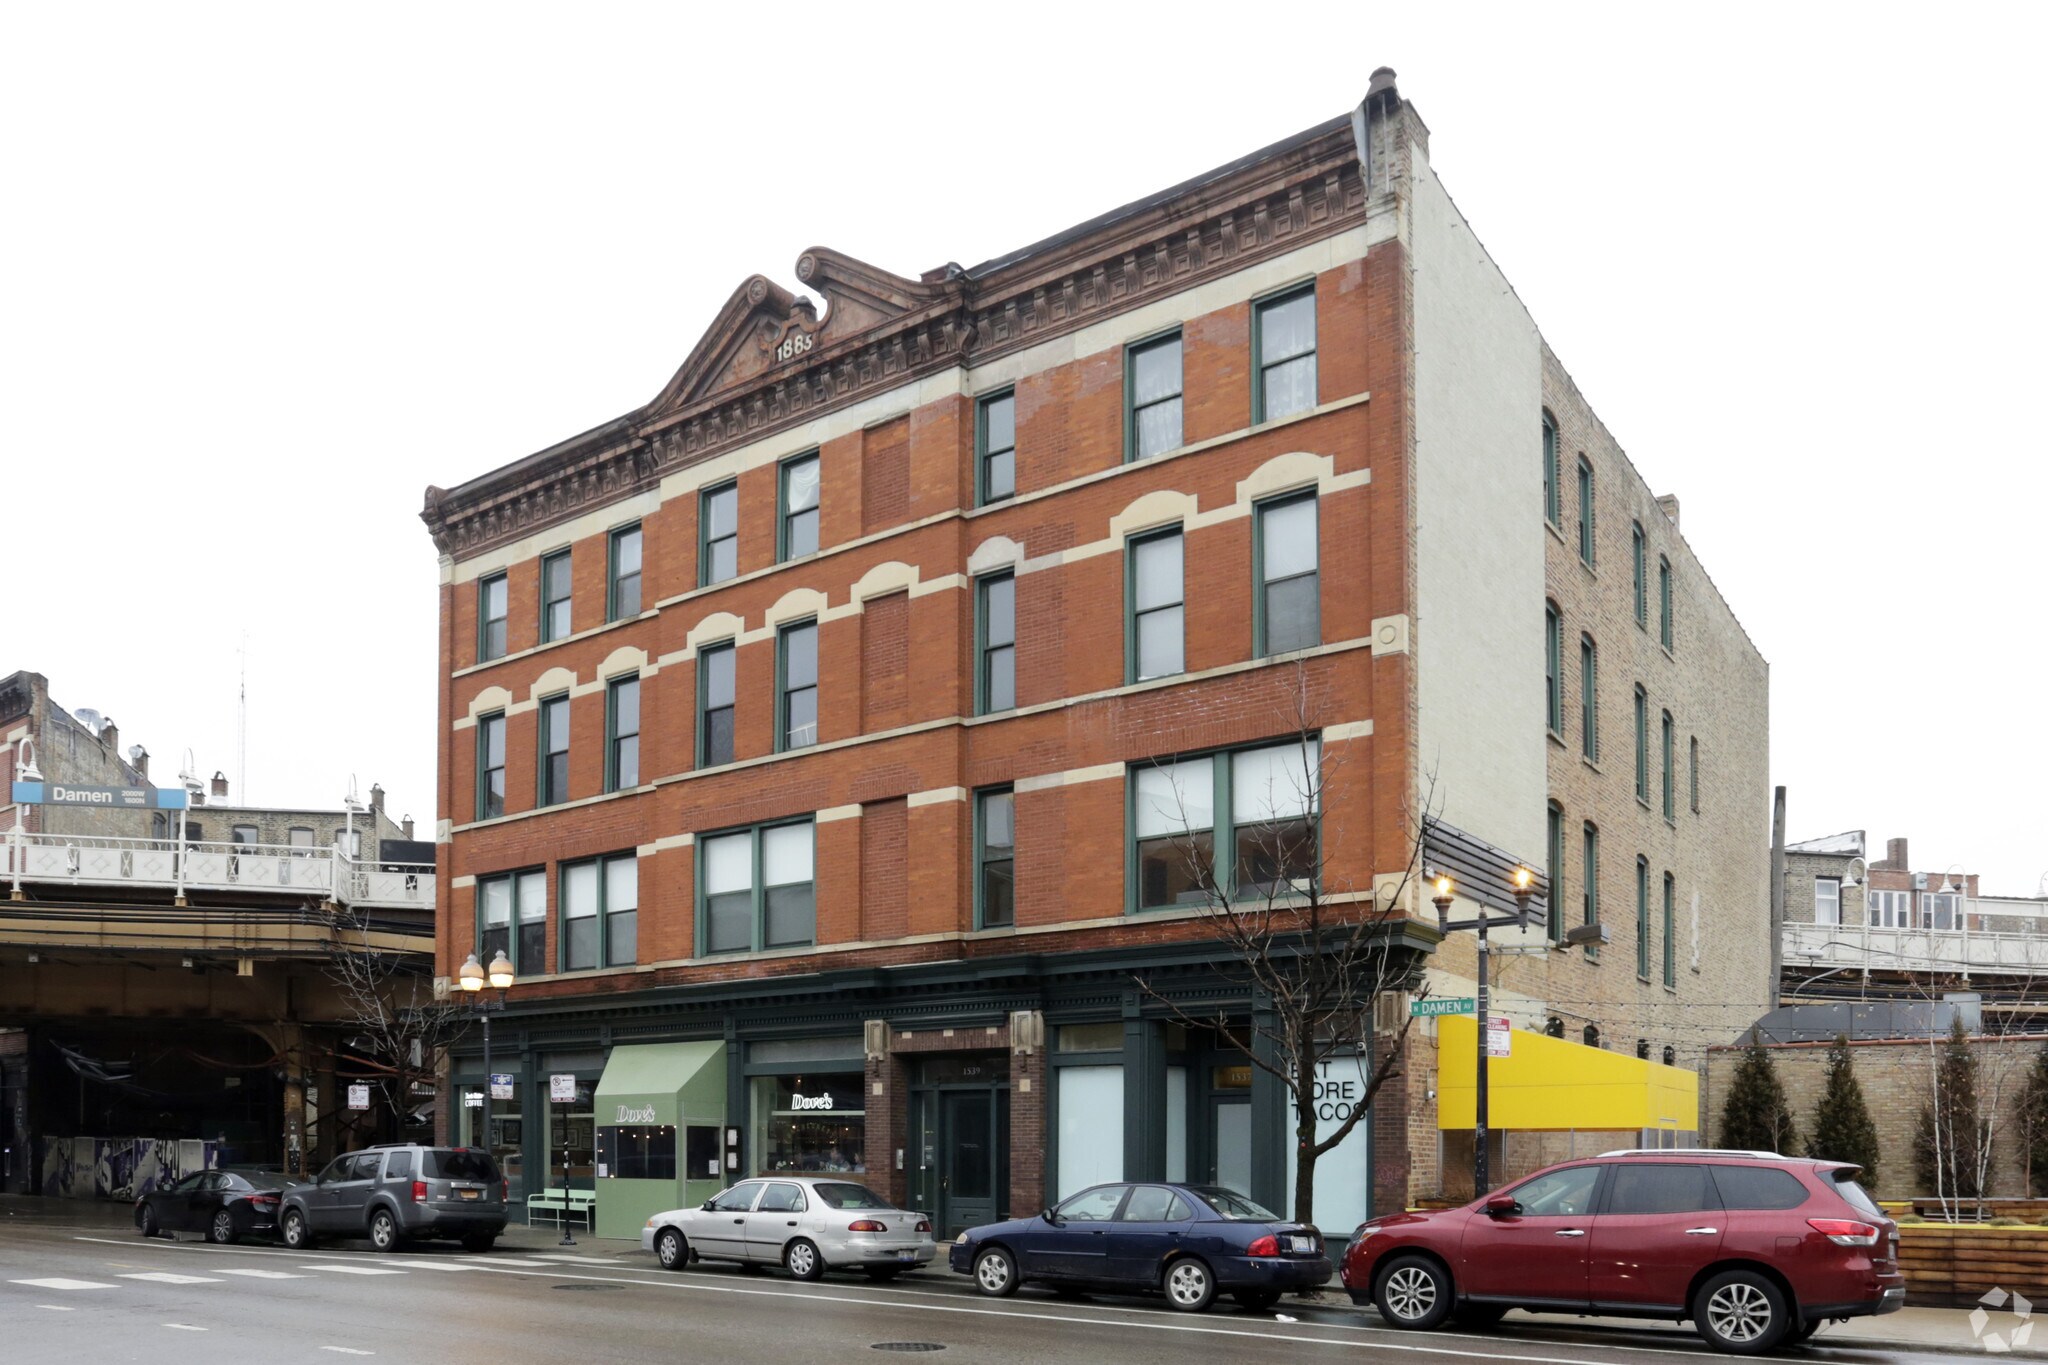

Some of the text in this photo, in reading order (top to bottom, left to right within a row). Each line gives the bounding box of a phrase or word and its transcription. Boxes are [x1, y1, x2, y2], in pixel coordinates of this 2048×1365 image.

[777, 333, 813, 362] 1885
[53, 787, 113, 803] Damen
[1413, 1005, 1419, 1013] N
[1422, 1001, 1461, 1014] DAMEN
[963, 1066, 981, 1076] 1539
[1291, 1082, 1354, 1099] ORE
[791, 1092, 833, 1110] Dove's
[615, 1103, 656, 1123] Dove's
